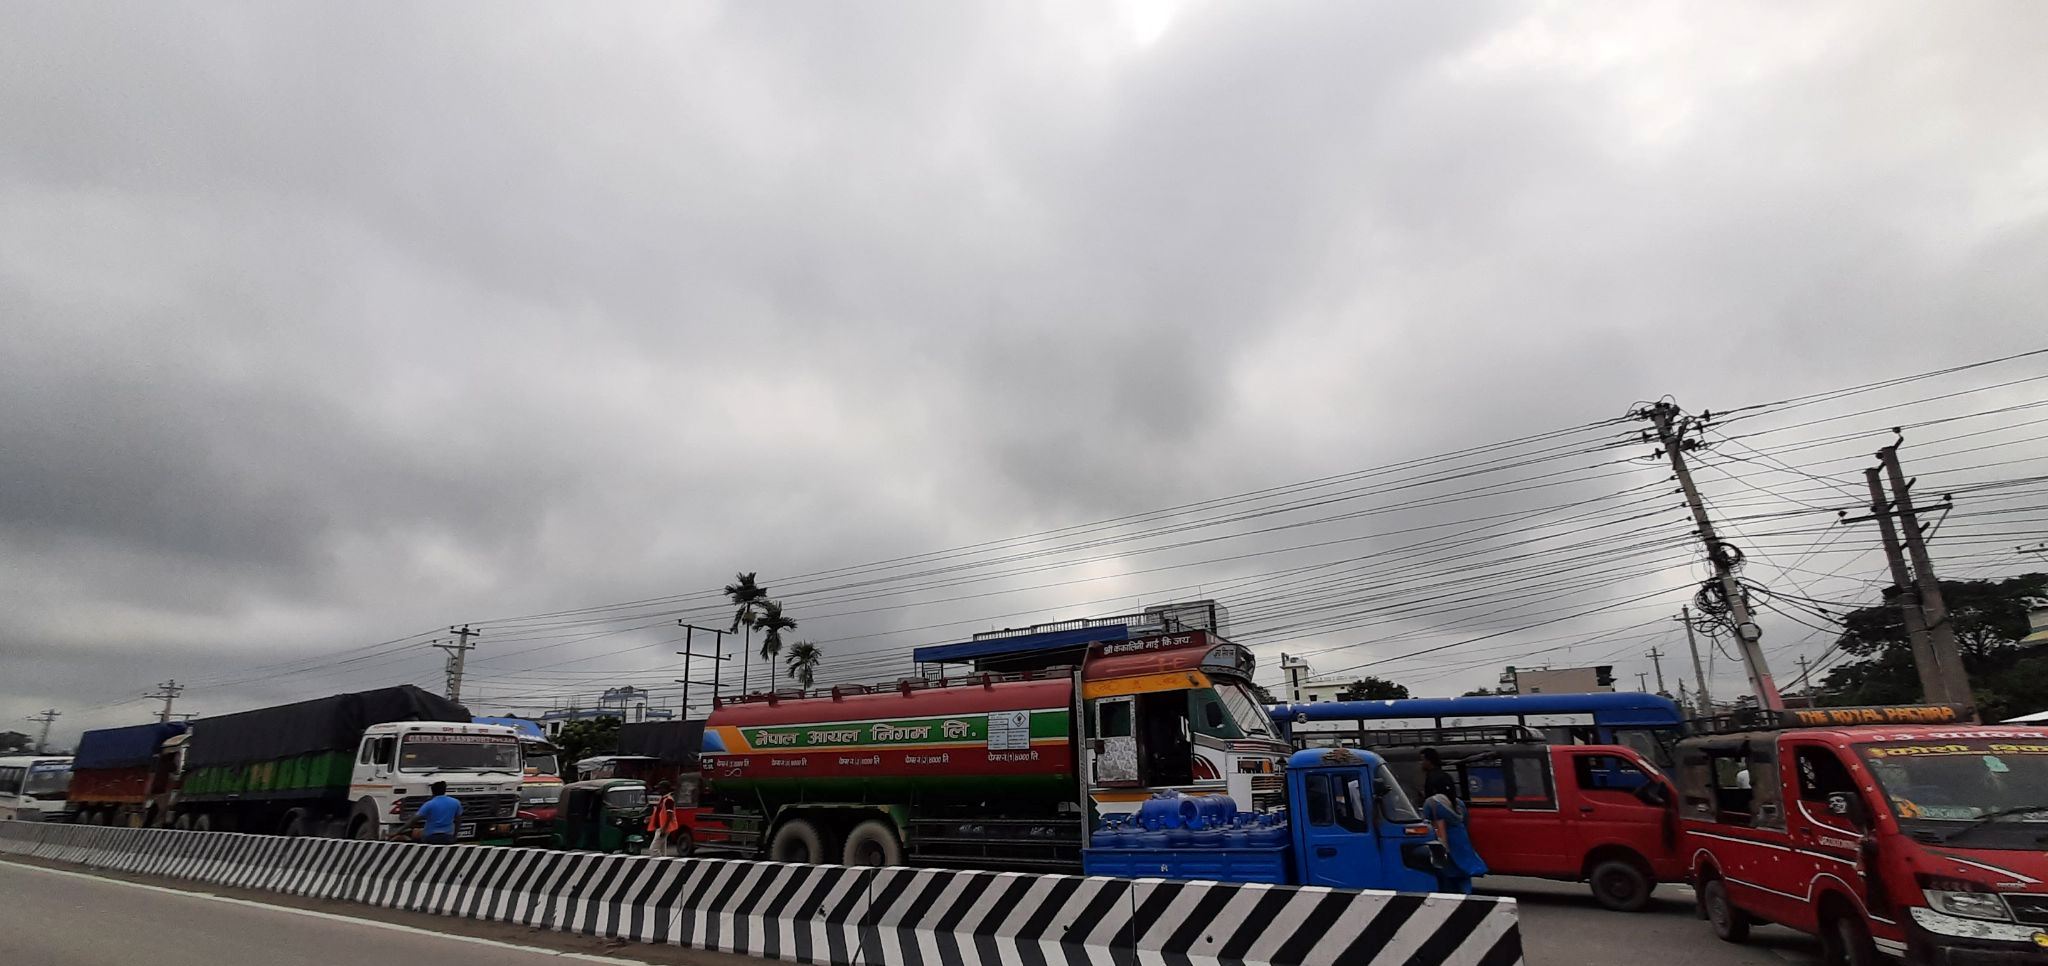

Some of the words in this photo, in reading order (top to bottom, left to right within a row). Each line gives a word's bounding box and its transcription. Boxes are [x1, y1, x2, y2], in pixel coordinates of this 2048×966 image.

[1795, 710, 1829, 725] THE
[755, 730, 800, 746] नेपाल
[807, 728, 861, 745] आयल
[870, 723, 932, 742] निगम
